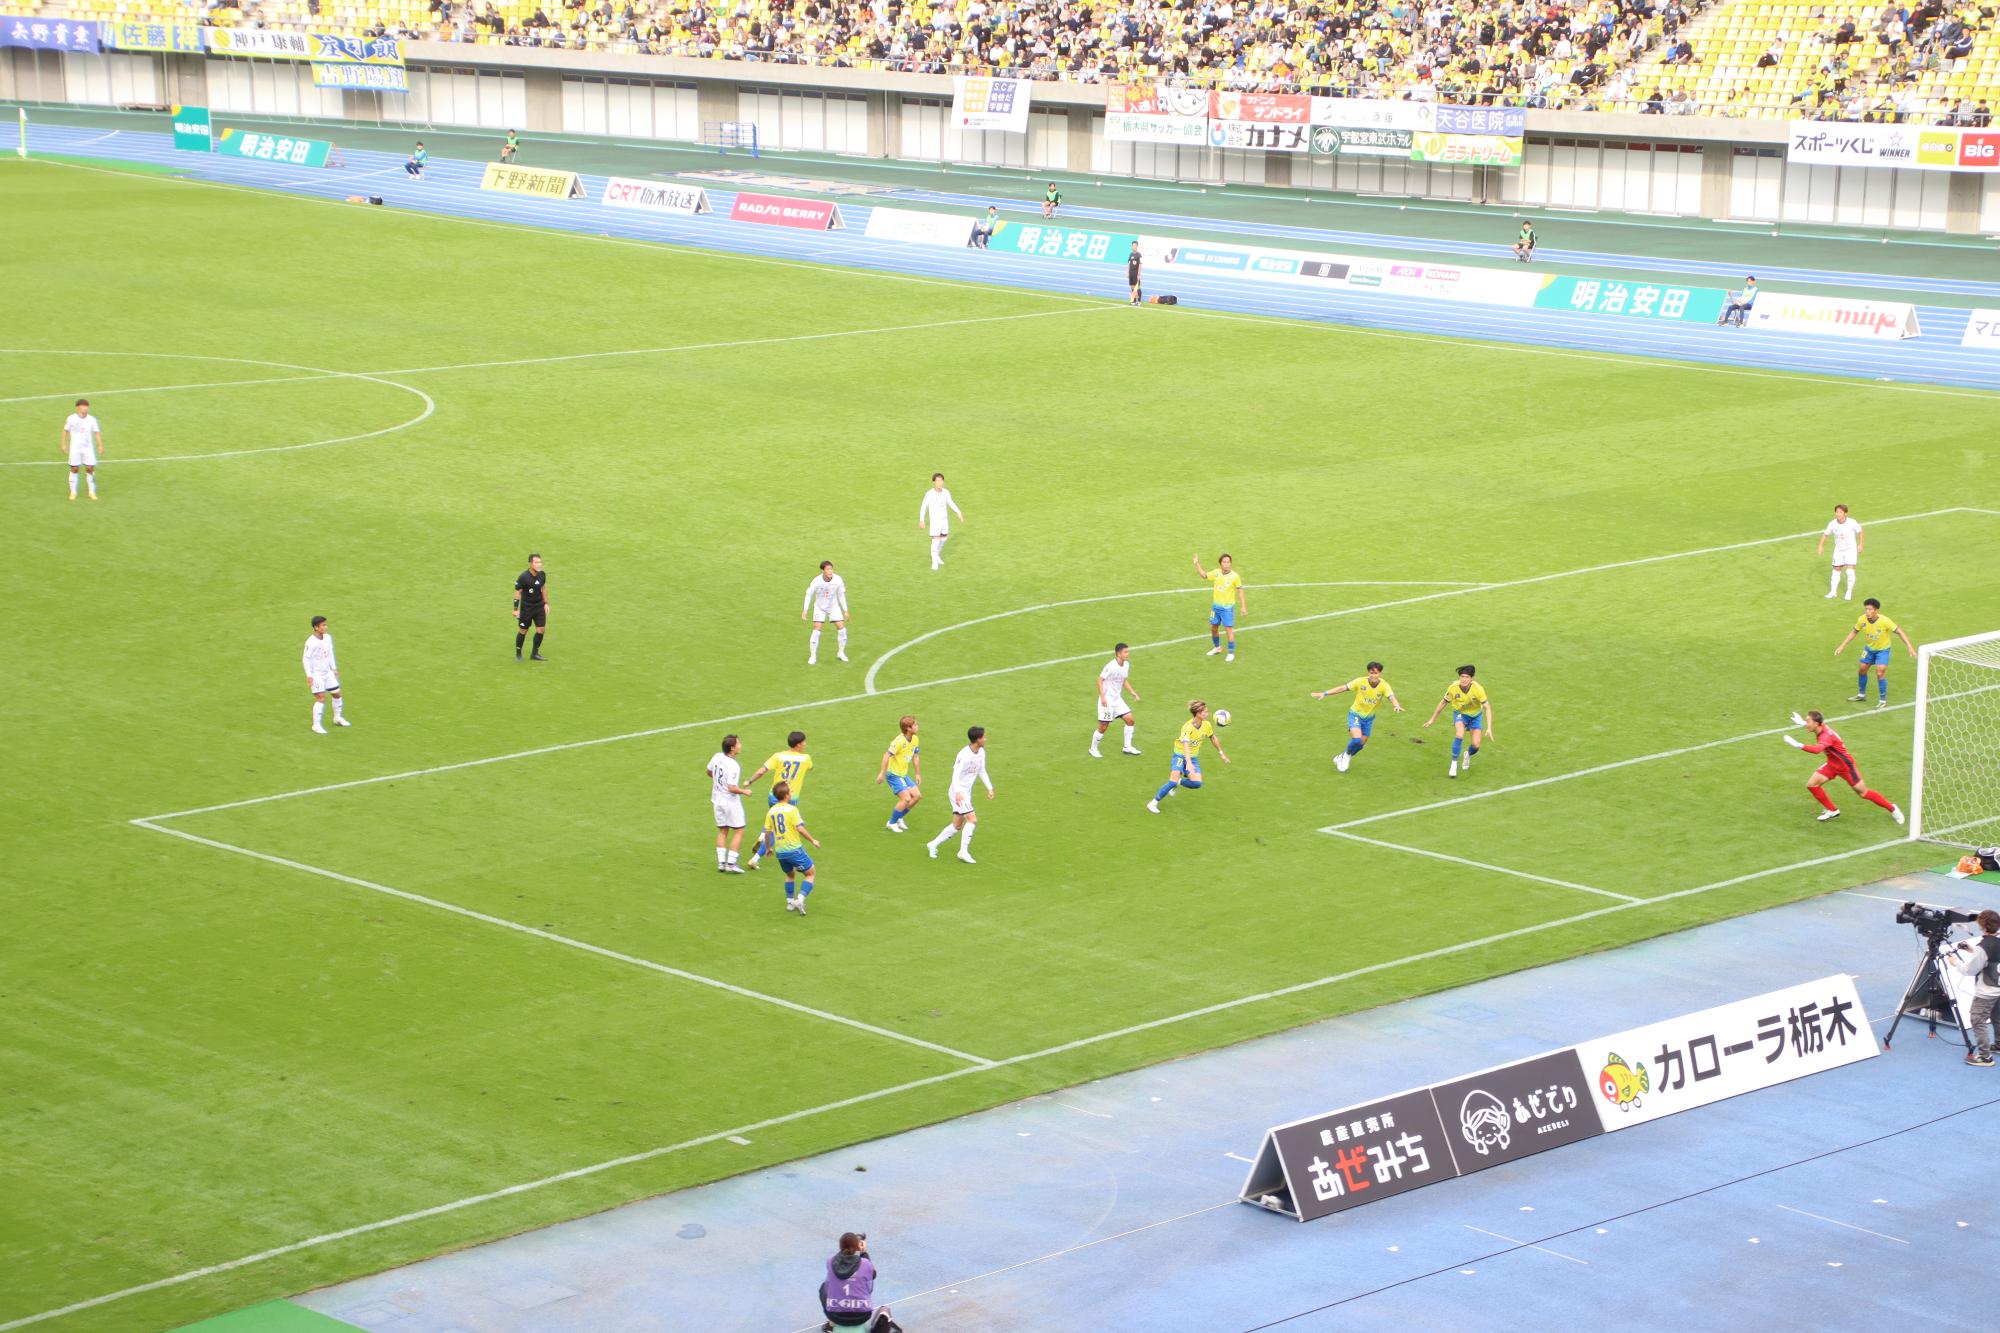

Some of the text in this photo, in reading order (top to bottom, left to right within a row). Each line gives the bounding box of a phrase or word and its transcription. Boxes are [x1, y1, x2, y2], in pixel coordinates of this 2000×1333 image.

[1123, 121, 1203, 137] 栃木県サッカー協会
[1245, 123, 1307, 149] カナメ
[1340, 130, 1412, 147] 宇都宮東武ホテル
[239, 133, 311, 163] 明治安田
[1794, 132, 1875, 154] スポーツくじ
[1879, 148, 1911, 159] WINNER
[489, 167, 567, 195] 下野新聞
[609, 182, 642, 201] CRT
[782, 206, 825, 221] BERRY
[1016, 226, 1112, 260] 明治安田
[1570, 280, 1691, 318] 明治安田
[781, 760, 801, 781] 37
[771, 813, 786, 835] 18
[1653, 995, 1857, 1094] カローラ栃木
[1512, 1084, 1578, 1124] あぜでり
[1537, 1119, 1570, 1135] AZEDELI
[1307, 1131, 1430, 1201] あぜみち
[843, 1283, 851, 1296] 1
